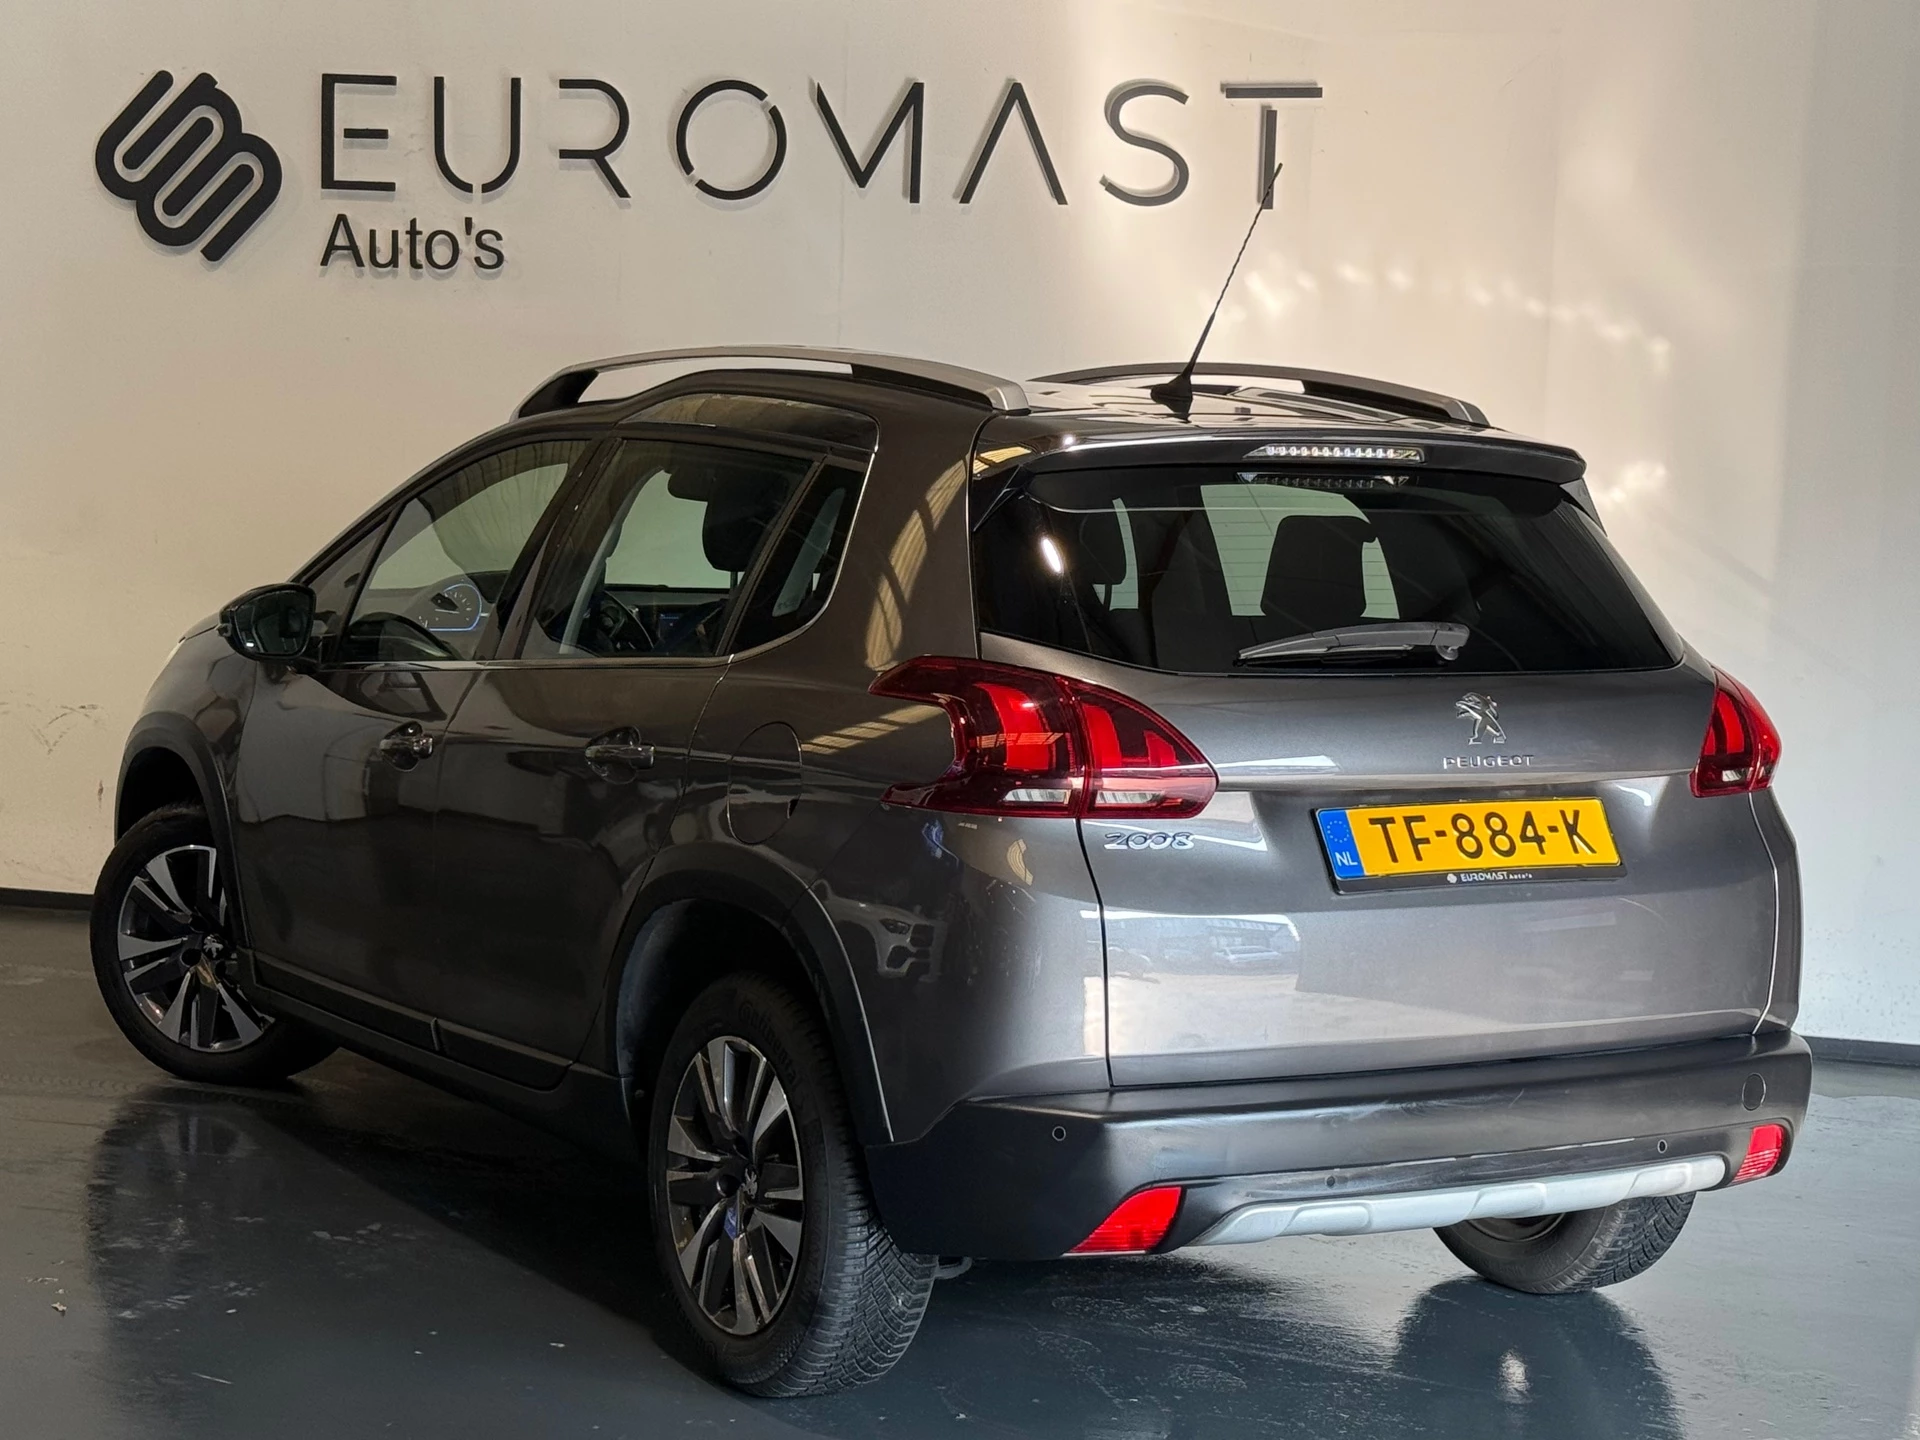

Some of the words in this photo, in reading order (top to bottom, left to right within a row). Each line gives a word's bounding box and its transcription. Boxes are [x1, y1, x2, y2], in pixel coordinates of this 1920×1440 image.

[321, 73, 1323, 209] EUROMAST
[320, 213, 505, 269] Auto's
[1443, 754, 1534, 769] PEUGEOT
[1104, 832, 1194, 850] 2008
[1368, 809, 1597, 863] TF-884-K
[1335, 851, 1358, 867] NL
[1460, 871, 1508, 882] EUROMAST
